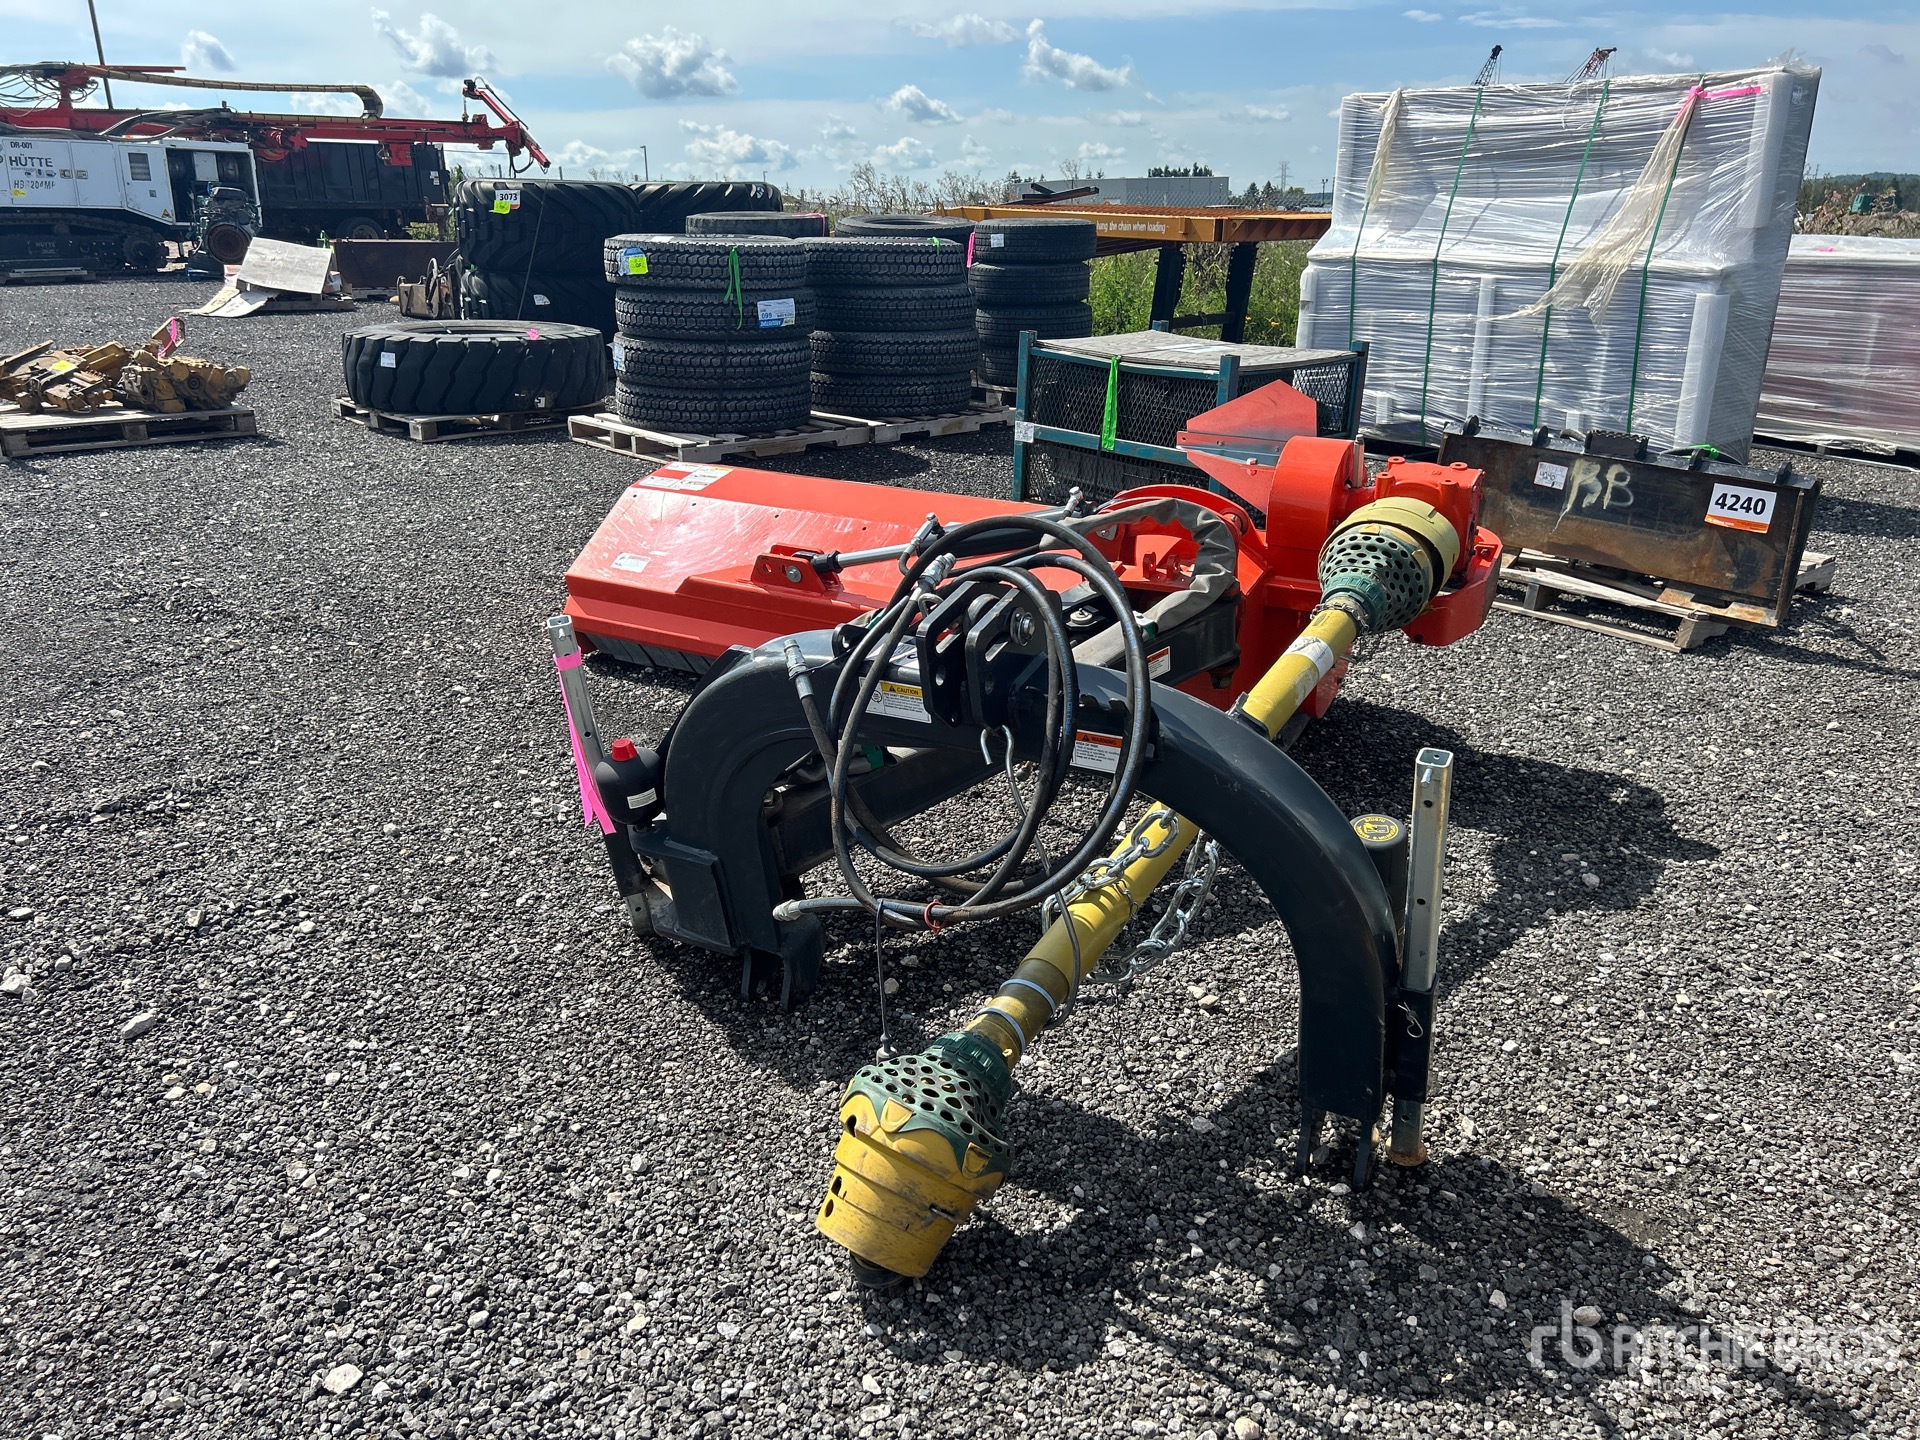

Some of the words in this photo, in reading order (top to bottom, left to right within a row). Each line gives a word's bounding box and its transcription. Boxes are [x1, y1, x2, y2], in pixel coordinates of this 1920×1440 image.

[10, 141, 33, 149] DR-001
[9, 153, 53, 167] HÜTTE
[499, 193, 518, 201] 3073
[1096, 220, 1108, 232] hang
[1109, 220, 1117, 231] the
[1118, 220, 1131, 231] chain
[1132, 221, 1147, 231] when
[1147, 221, 1166, 234] loading
[1714, 492, 1767, 515] 4240
[896, 687, 919, 695] CAUTION
